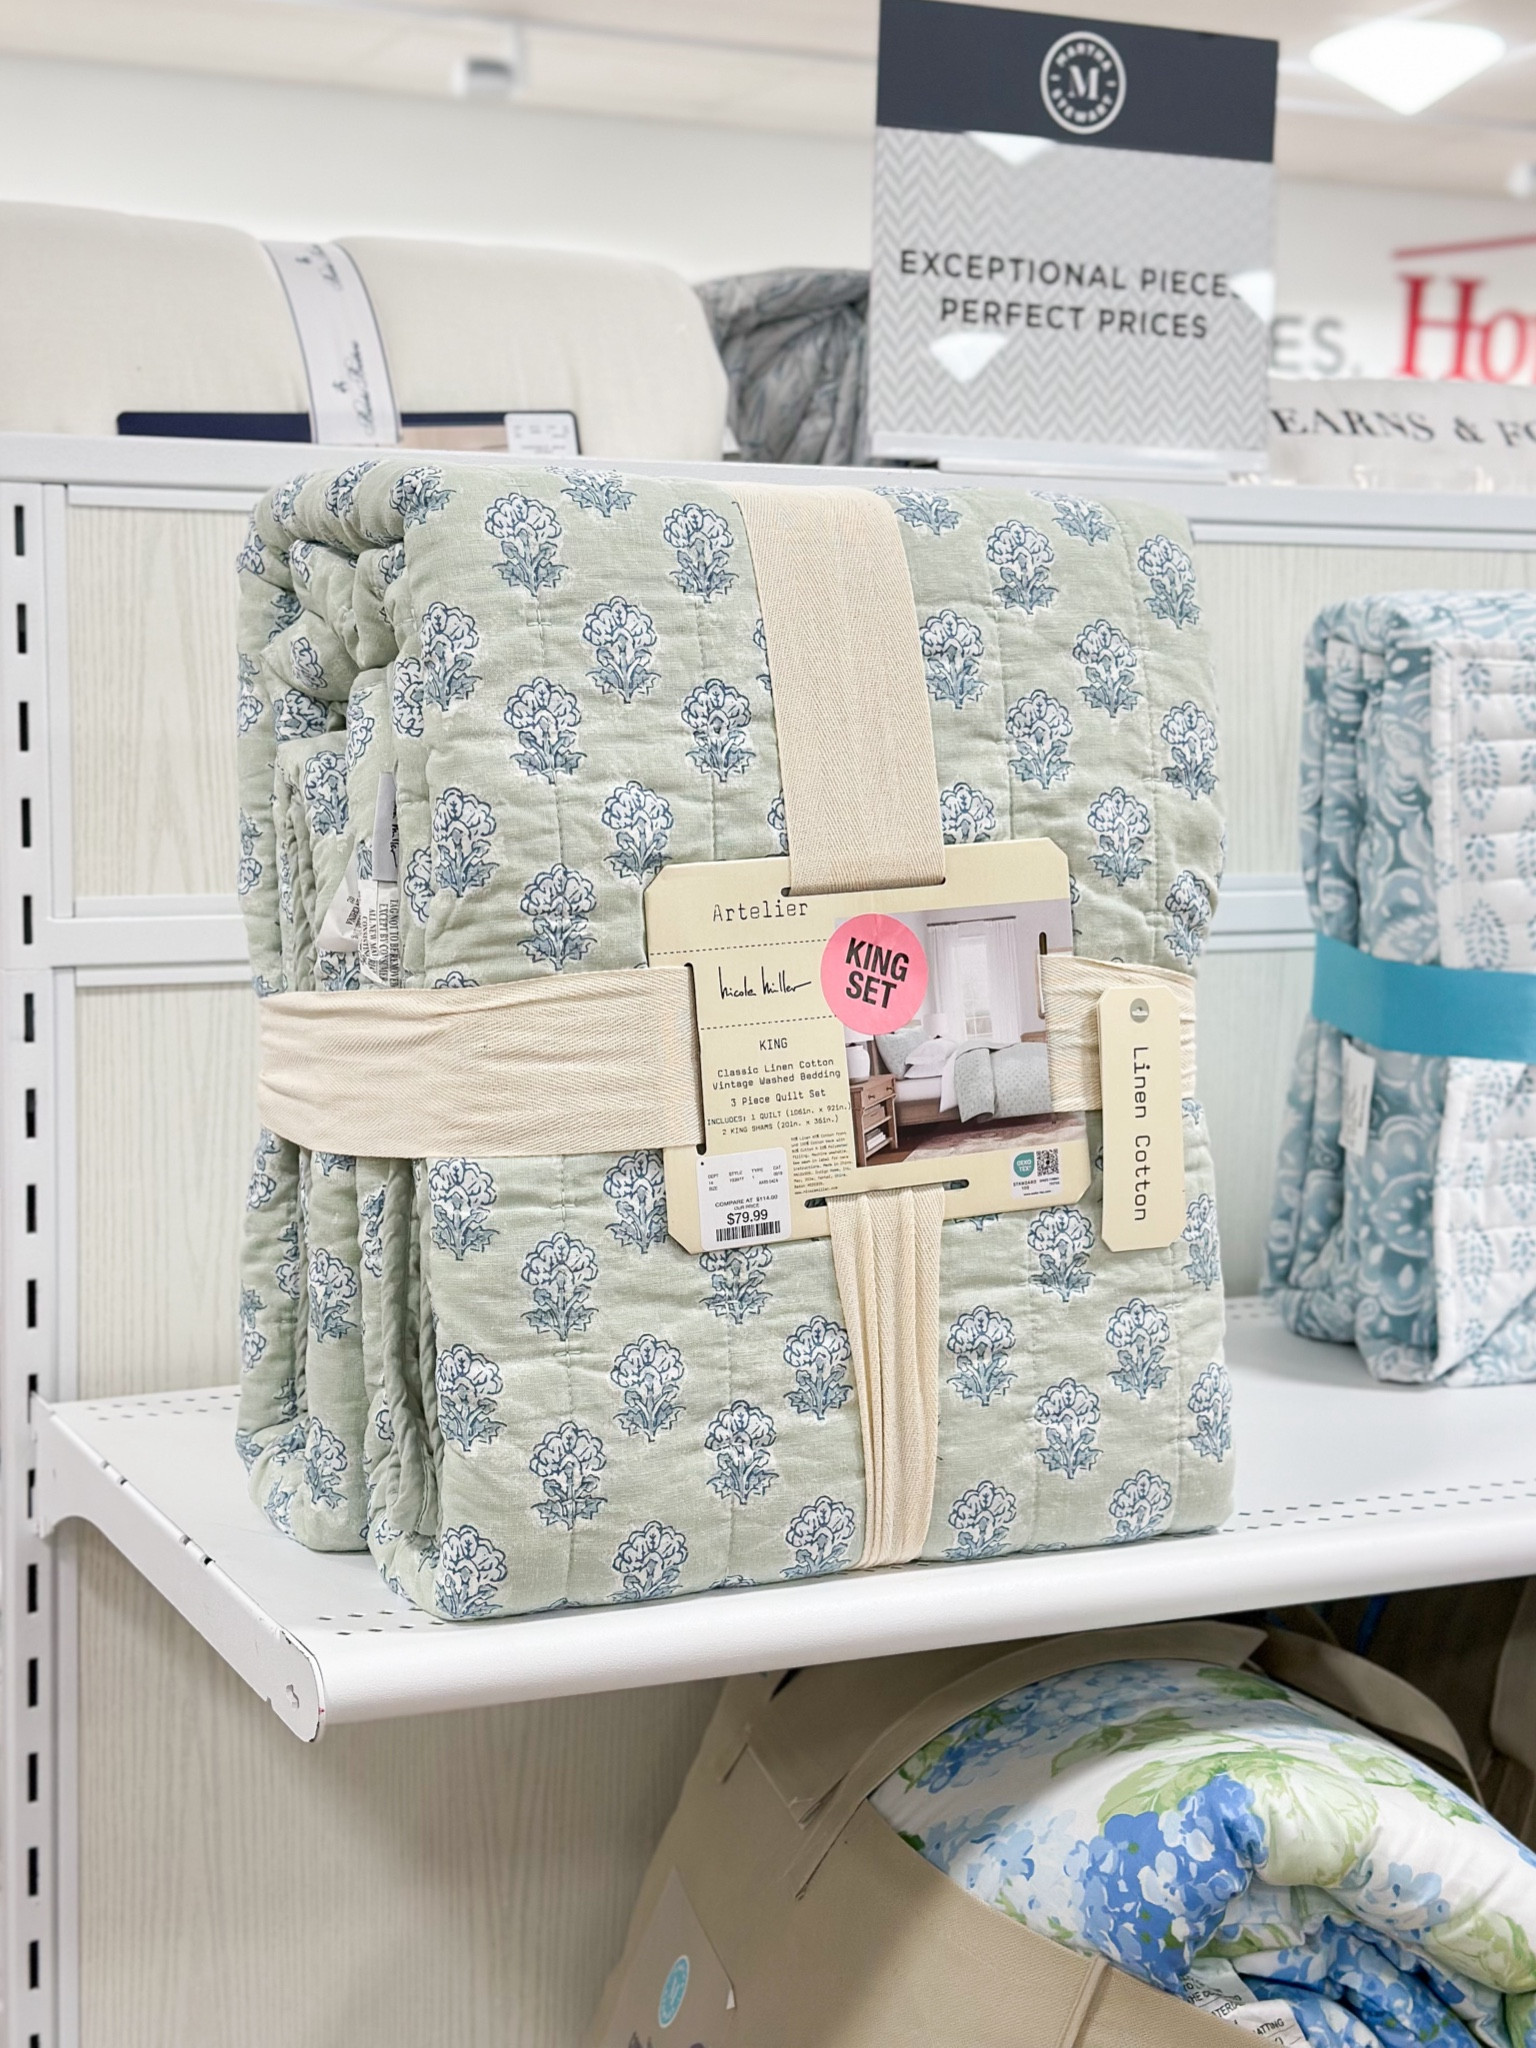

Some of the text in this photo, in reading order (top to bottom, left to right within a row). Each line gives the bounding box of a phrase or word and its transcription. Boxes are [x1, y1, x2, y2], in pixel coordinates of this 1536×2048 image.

[1067, 64, 1099, 100] M
[900, 249, 1240, 299] EXCEPTIONAL PIECE
[940, 298, 1208, 339] PERFECT PRICES
[1397, 275, 1536, 385] Ho
[1453, 416, 1485, 444] &
[379, 903, 388, 933] EXCEPT
[712, 899, 808, 922] Artelier
[390, 914, 399, 930] NOT
[390, 931, 399, 942] TO
[845, 936, 909, 982] KING
[845, 970, 897, 1009] SET
[759, 1037, 788, 1051] KING
[717, 1058, 834, 1078] Classic Linen Cotton
[712, 1069, 841, 1091] Vintage Washed Bedding
[730, 1088, 826, 1108] 3 Piece Quilt Set
[751, 1113, 756, 1121] 1
[759, 1110, 781, 1121] QUILT
[722, 1128, 727, 1136] 2
[730, 1126, 748, 1135] KING
[752, 1123, 773, 1132] SHAMS
[1133, 1046, 1151, 1222] Linen Cotton
[714, 1199, 744, 1208] COMPARE
[727, 1208, 768, 1225] $79.99
[1253, 2017, 1285, 2035] ATTING
